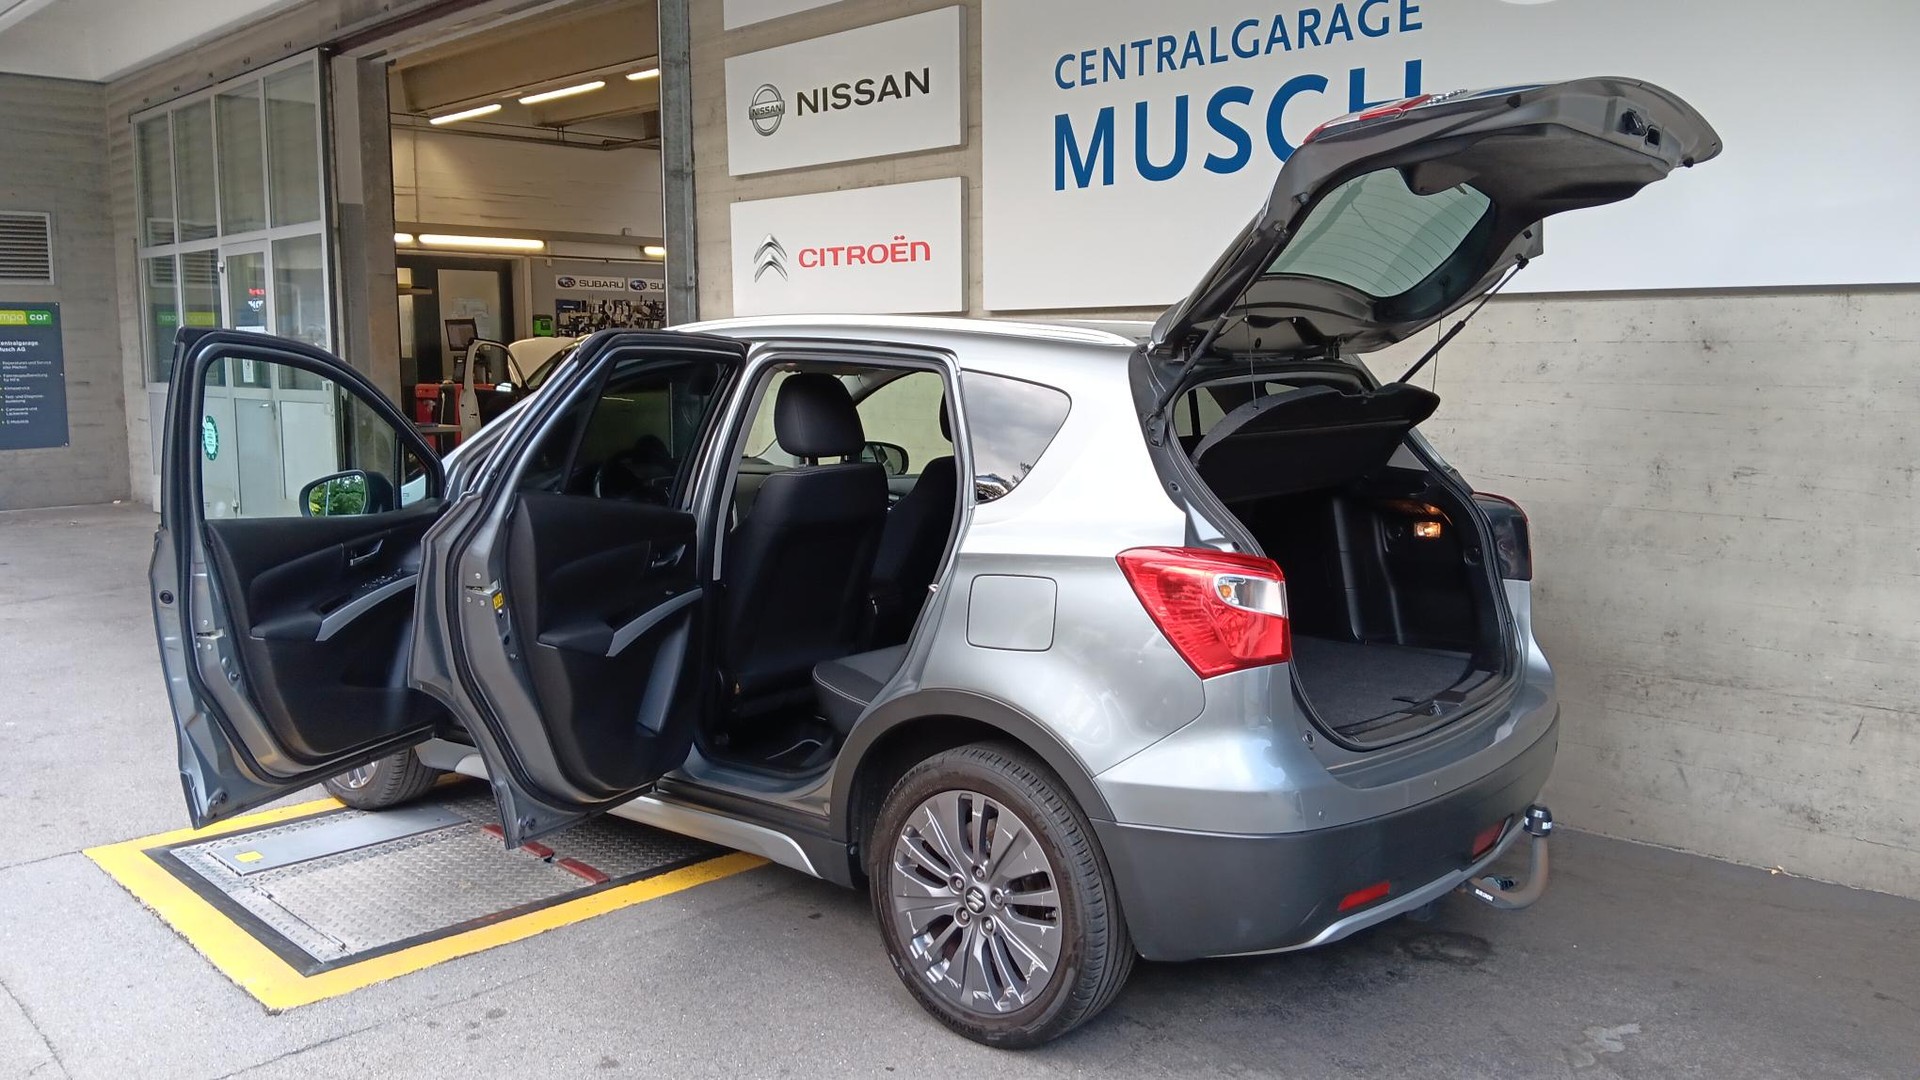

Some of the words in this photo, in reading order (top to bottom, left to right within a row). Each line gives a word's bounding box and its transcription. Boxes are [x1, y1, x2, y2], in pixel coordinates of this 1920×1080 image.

[1055, 0, 1423, 90] CENTRALGARAGE
[797, 67, 930, 116] NISSAN
[751, 103, 783, 116] NISSAN
[579, 279, 624, 289] SUBARU
